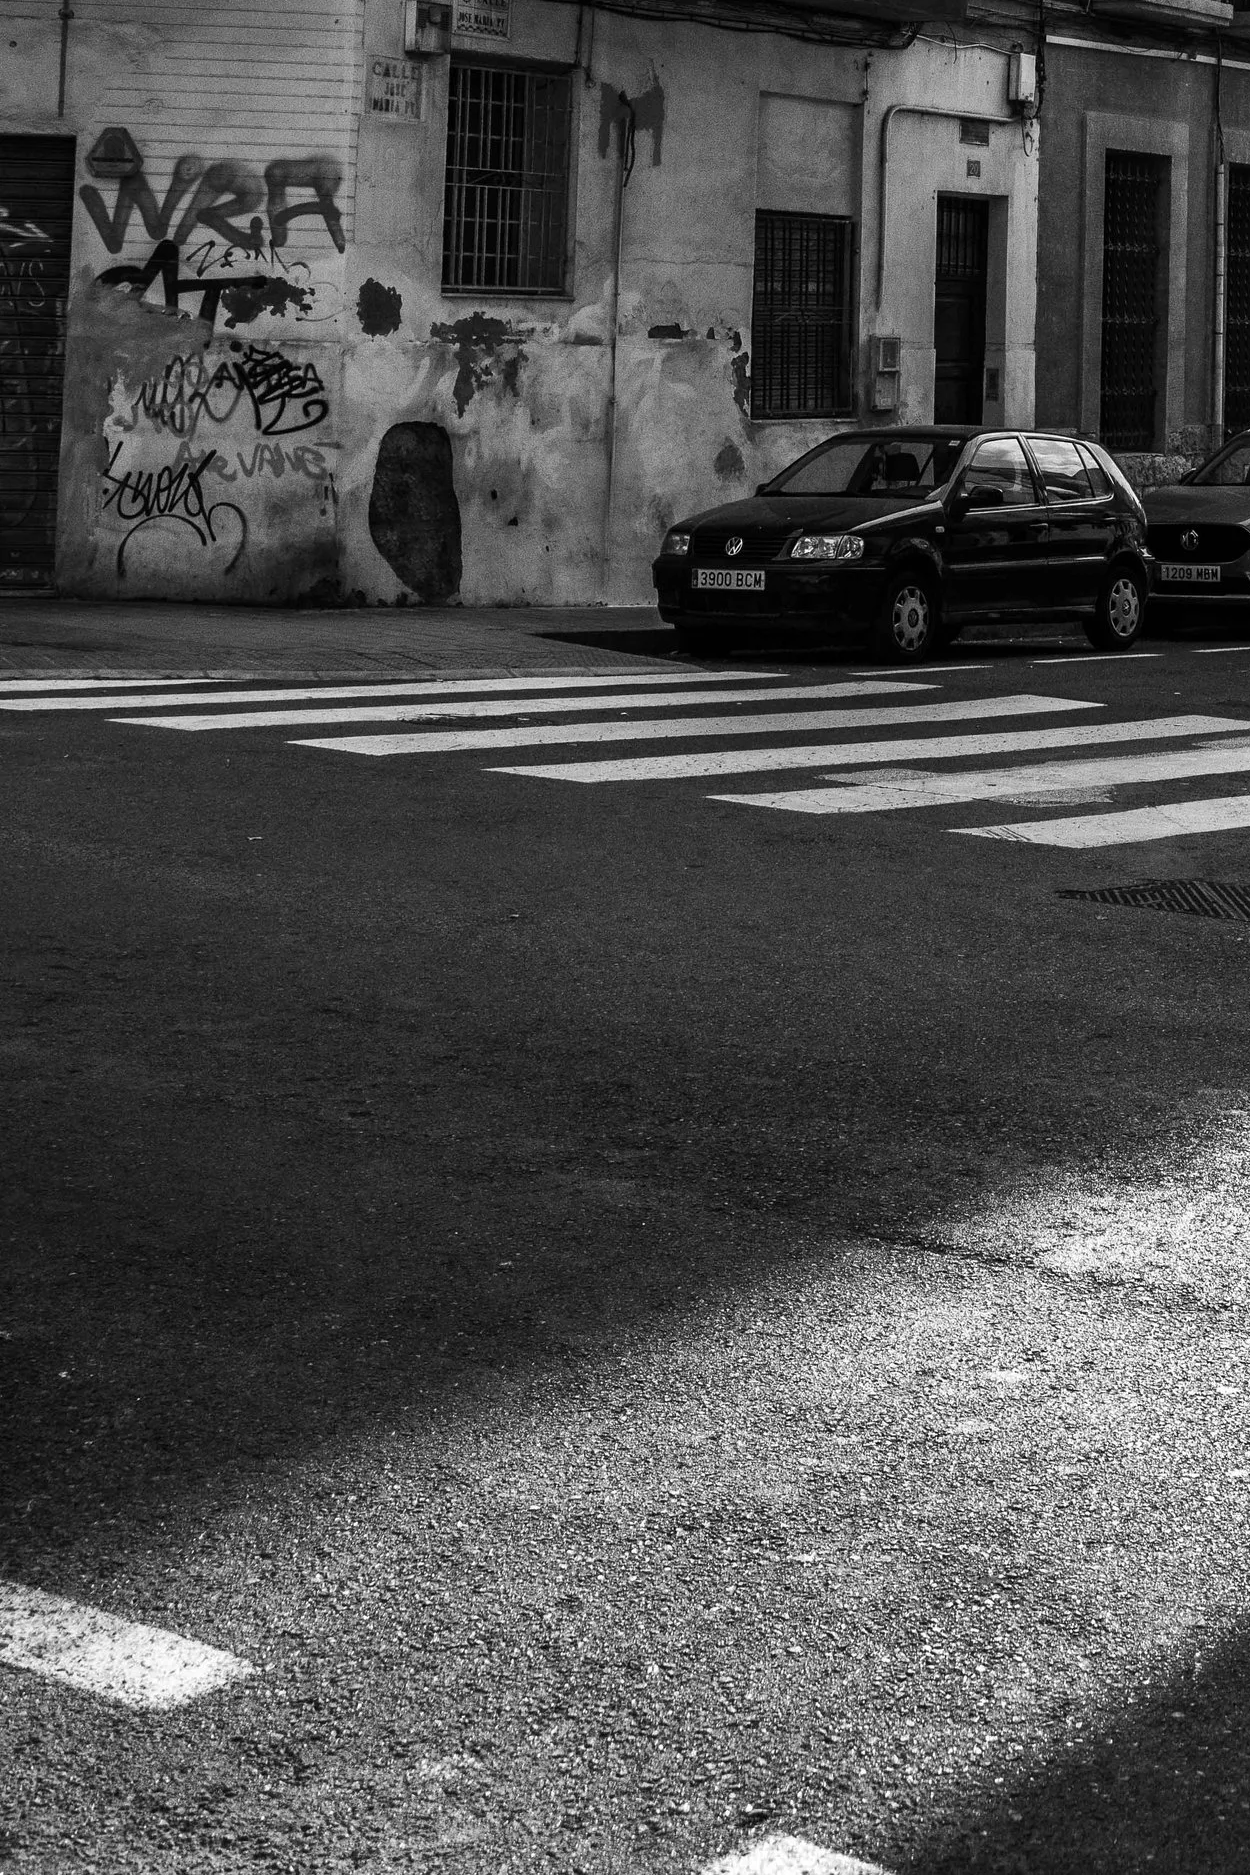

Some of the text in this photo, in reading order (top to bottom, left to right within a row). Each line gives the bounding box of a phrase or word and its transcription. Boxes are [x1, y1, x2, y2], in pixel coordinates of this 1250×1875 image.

[372, 61, 418, 80] CALLE
[701, 571, 762, 588] 3900 BCM
[1165, 567, 1218, 581] 1209 MBM
